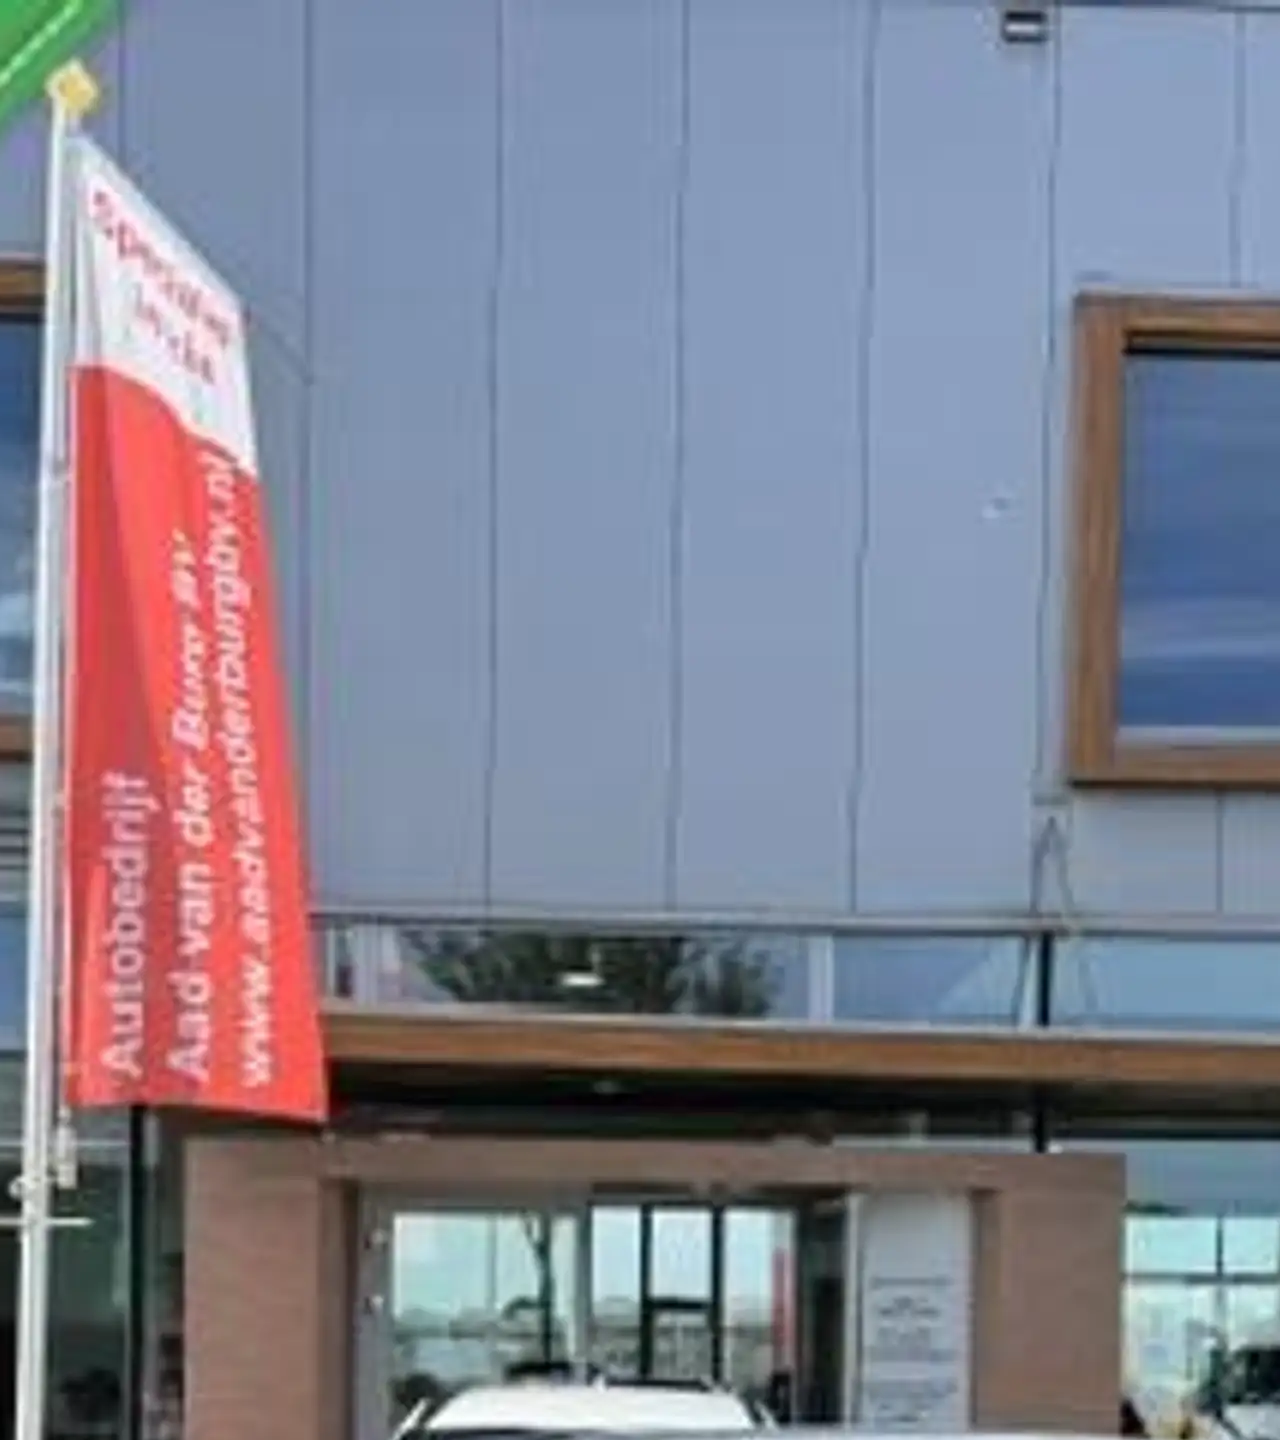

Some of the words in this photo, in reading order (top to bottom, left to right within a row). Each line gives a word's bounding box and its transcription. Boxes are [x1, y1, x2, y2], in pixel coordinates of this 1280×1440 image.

[173, 757, 215, 849] der
[100, 769, 162, 1079] Autobedrijf
[177, 862, 213, 957] van
[166, 969, 213, 1086] Aad
